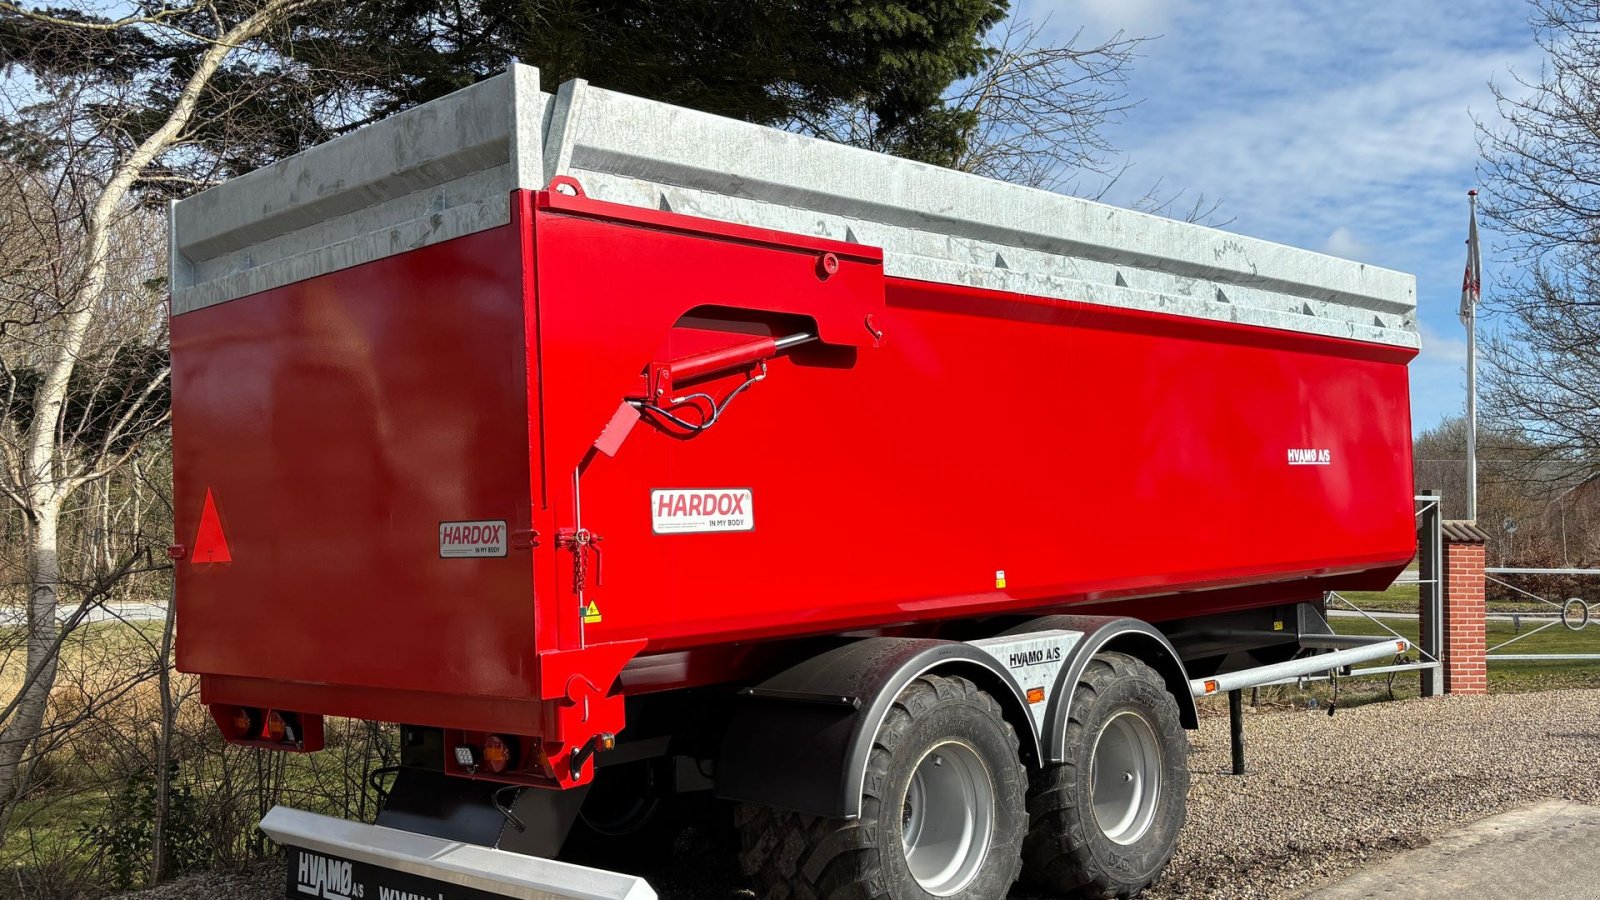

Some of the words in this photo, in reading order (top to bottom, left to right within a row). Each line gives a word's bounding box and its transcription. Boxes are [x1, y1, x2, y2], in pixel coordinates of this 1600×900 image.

[657, 493, 745, 517] HARDOX
[443, 525, 501, 545] HARDOX
[1009, 650, 1043, 666] HVAMØ
[1046, 646, 1061, 660] A/S
[298, 851, 352, 896] HVAMØ
[352, 882, 364, 898] A/S
